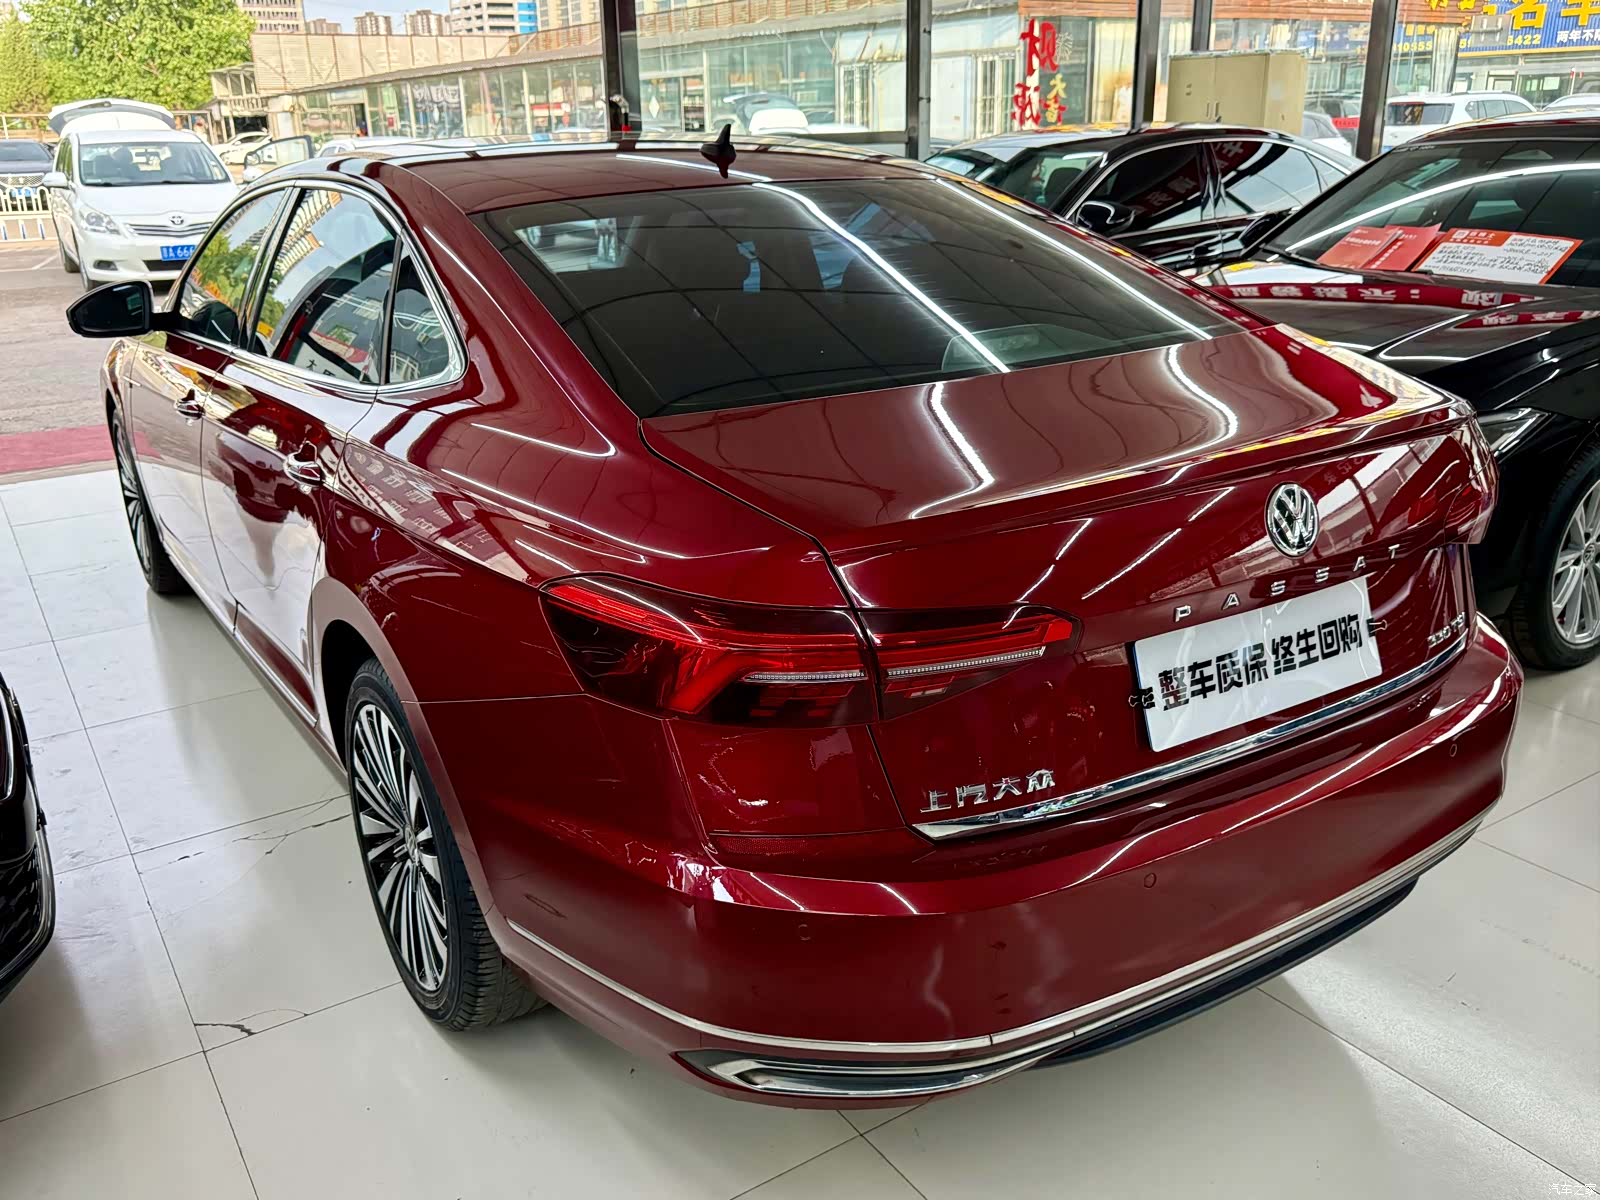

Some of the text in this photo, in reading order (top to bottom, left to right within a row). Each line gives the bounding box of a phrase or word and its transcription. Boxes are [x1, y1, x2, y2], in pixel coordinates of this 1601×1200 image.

[1175, 543, 1400, 622] PASSAT
[1158, 613, 1361, 711] 整车质保 终生回购
[920, 768, 1056, 813] 上汽大众
